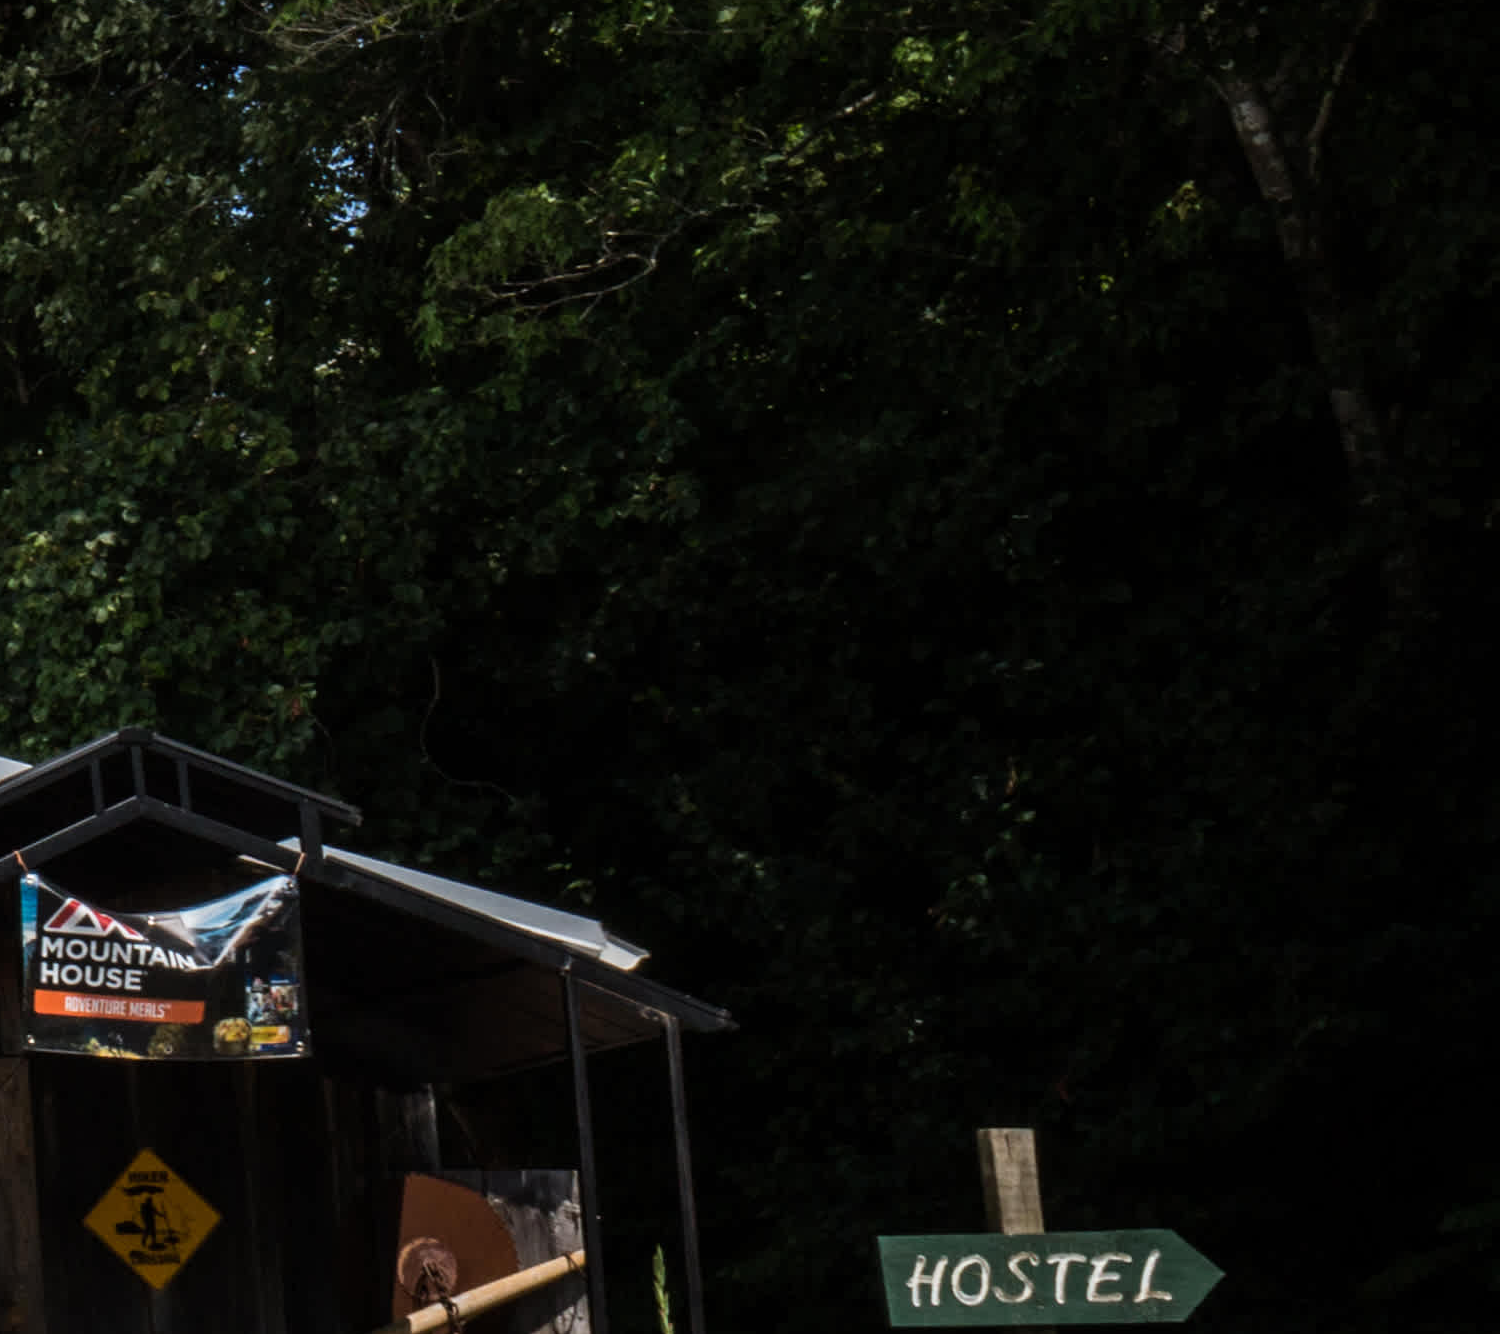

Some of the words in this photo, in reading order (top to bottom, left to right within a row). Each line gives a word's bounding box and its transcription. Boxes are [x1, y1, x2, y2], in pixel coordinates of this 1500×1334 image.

[41, 935, 197, 970] MOUNTAIN
[40, 962, 143, 991] HOUSE
[64, 995, 128, 1015] ADVENTURE
[906, 1249, 1172, 1307] HOSTEL
